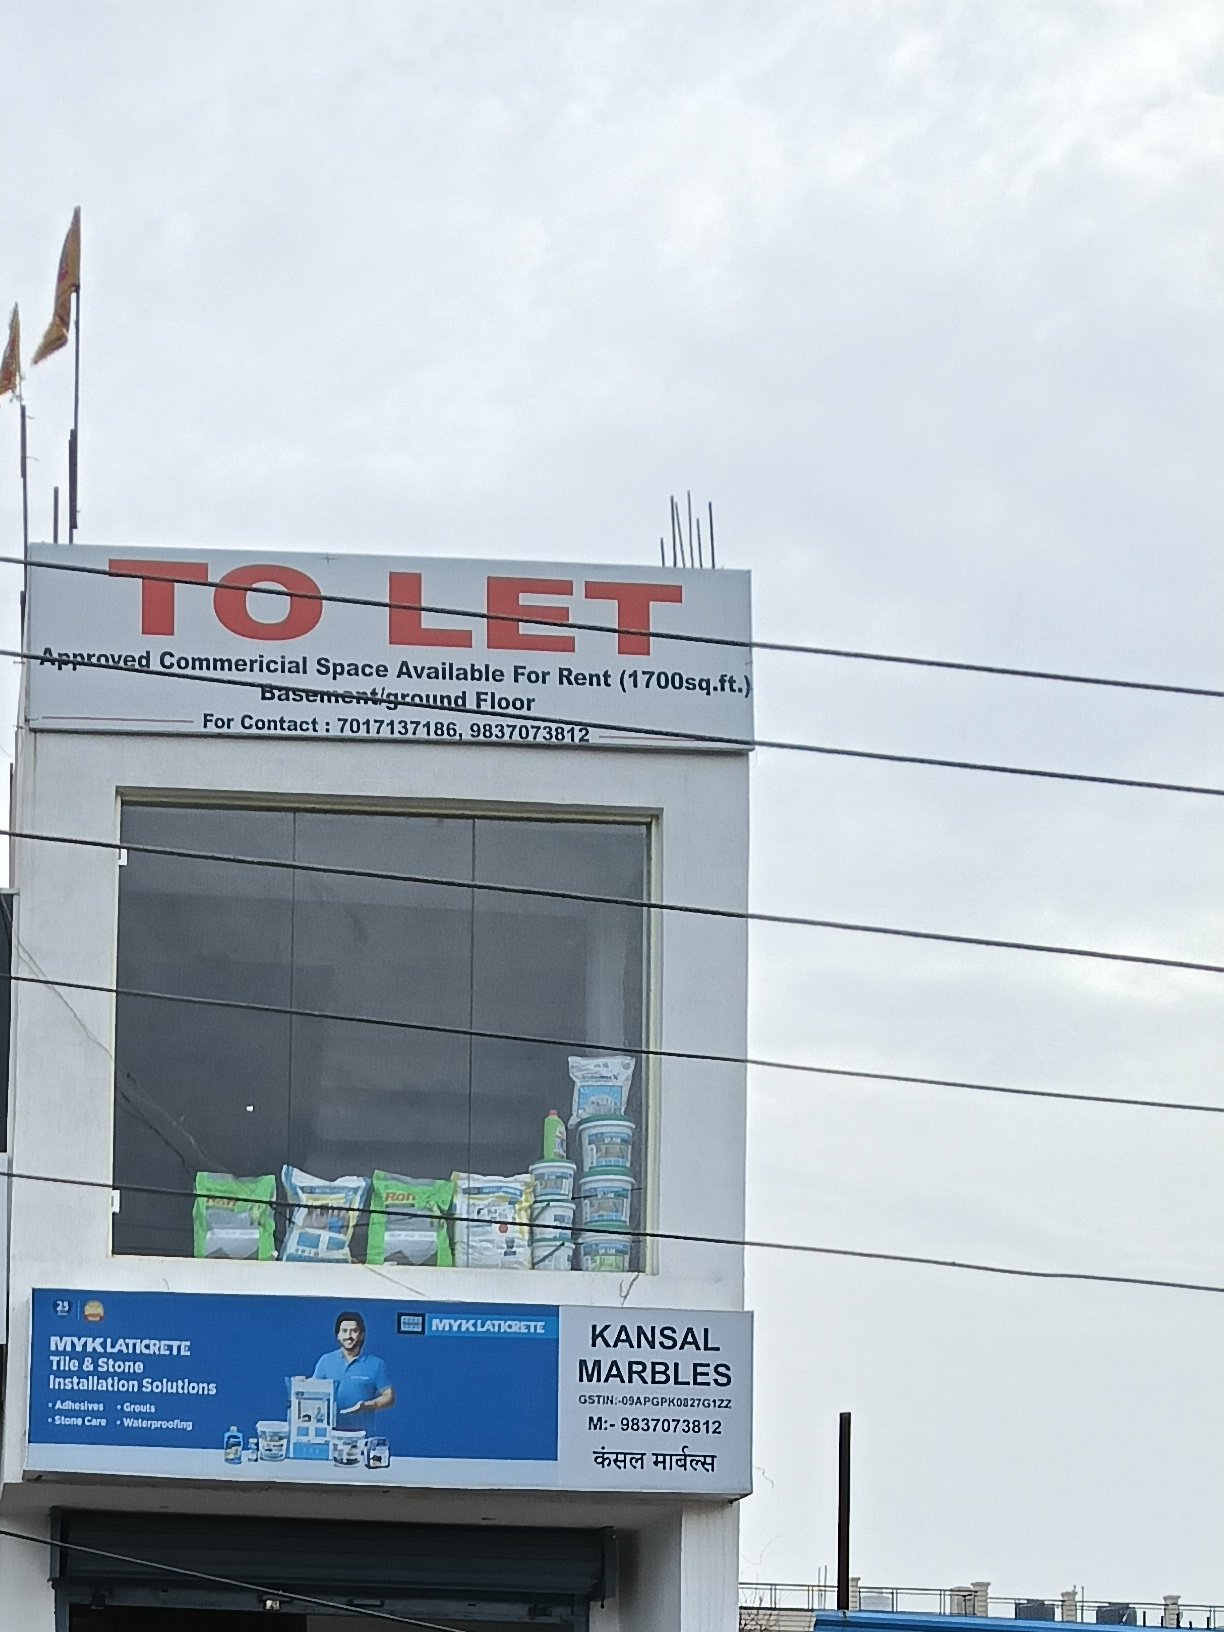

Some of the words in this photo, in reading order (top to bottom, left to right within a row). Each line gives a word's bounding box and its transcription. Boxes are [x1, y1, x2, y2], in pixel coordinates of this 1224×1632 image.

[108, 557, 323, 641] TO
[388, 571, 683, 656] LET
[39, 647, 151, 671] Approved
[159, 651, 308, 675] Commericial
[316, 657, 389, 680] Space
[396, 660, 506, 684] Available
[513, 665, 550, 685] For
[558, 667, 612, 688] Rent
[619, 670, 752, 698] (1700sq.ft.)
[475, 691, 536, 712] Floor
[202, 713, 234, 731] For
[240, 714, 319, 734] Contact
[337, 717, 463, 739] 7017137186,
[469, 722, 591, 743] 9837073812
[432, 1318, 476, 1332] MYK
[477, 1319, 546, 1334] LATICRETE
[49, 1336, 105, 1353] MYK
[106, 1338, 191, 1356] LATICRETE
[590, 1323, 721, 1352] KANSAL
[49, 1356, 79, 1371] Tile
[82, 1357, 94, 1372] &
[97, 1357, 144, 1373] Stone
[578, 1359, 732, 1387] MARBLES
[49, 1374, 138, 1392] Installation
[142, 1378, 217, 1395] Solutions
[54, 1400, 104, 1411] Adhesives
[123, 1402, 156, 1413] Grouts
[54, 1415, 83, 1426] Stone
[84, 1416, 107, 1427] Care
[122, 1417, 193, 1431] Waterproofing
[588, 1416, 616, 1431] M:-
[620, 1416, 722, 1435] 9837073812
[592, 1445, 647, 1470] कंसल
